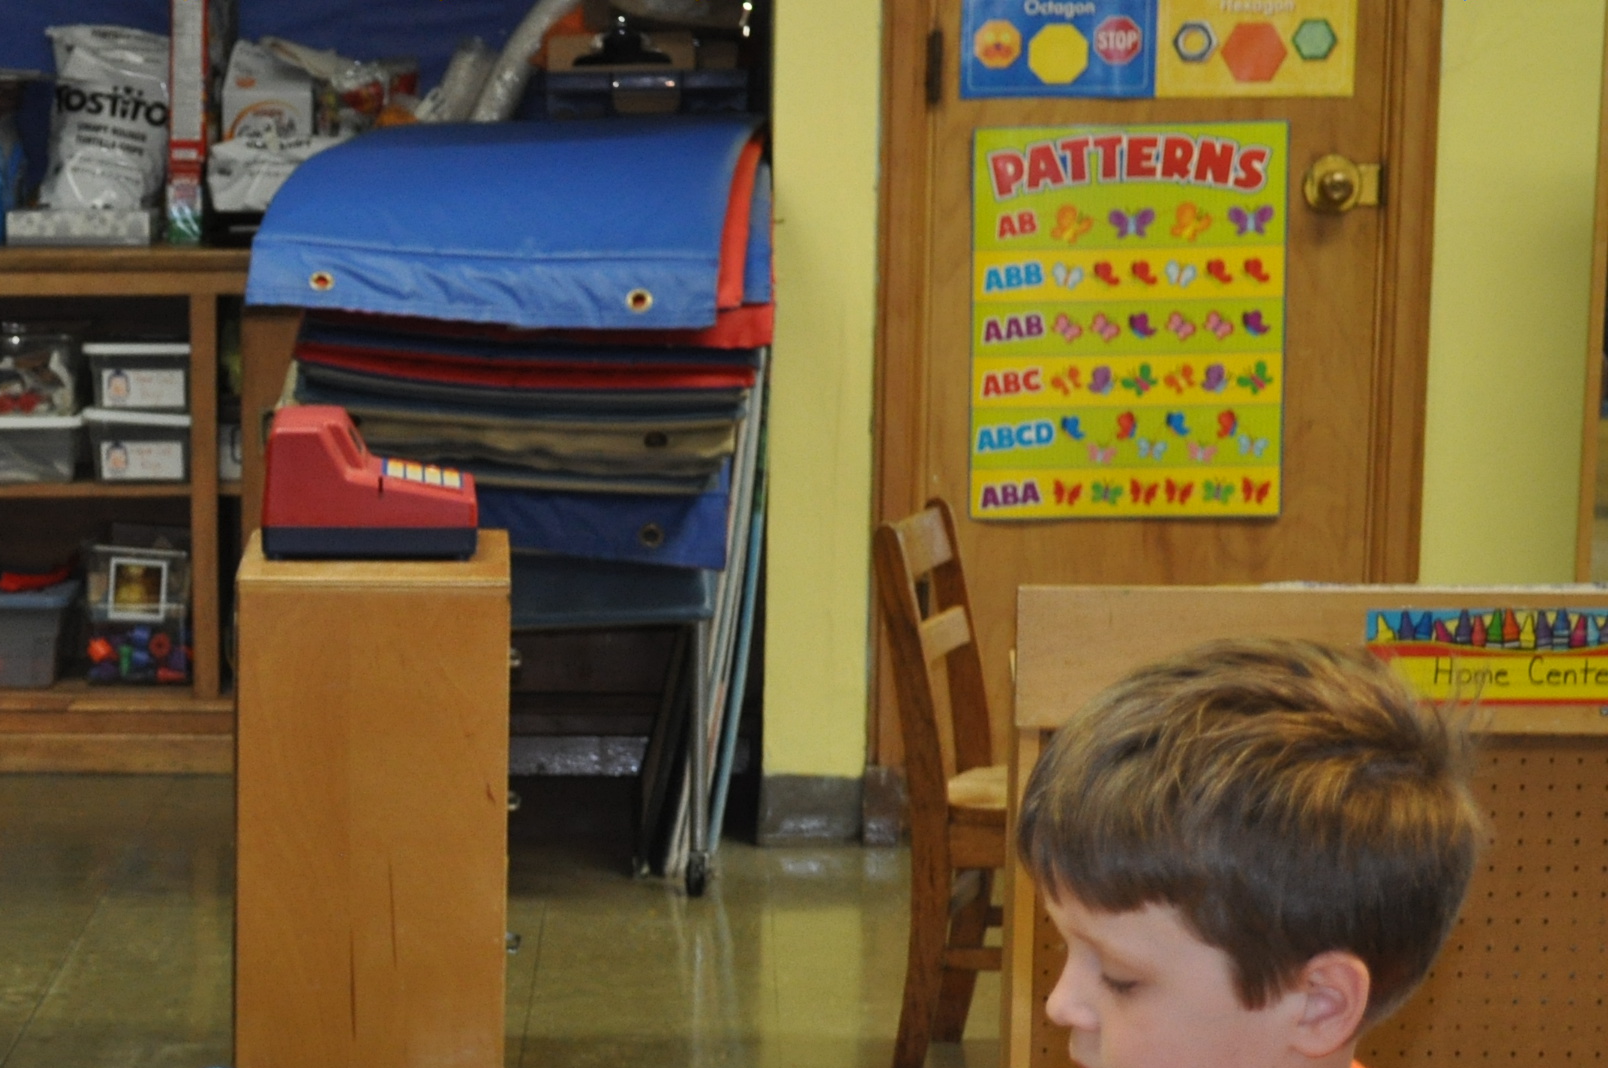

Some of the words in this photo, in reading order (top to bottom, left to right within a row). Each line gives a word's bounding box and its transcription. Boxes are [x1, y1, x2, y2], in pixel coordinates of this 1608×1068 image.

[1023, 0, 1096, 19] Octagon
[1097, 31, 1139, 51] STOP
[55, 85, 169, 126] TOSTITO
[990, 135, 1270, 199] PATTERNS
[997, 211, 1038, 239] AB
[984, 262, 1044, 292] ABB
[983, 315, 1044, 342] AAB
[983, 369, 1042, 396] ABC
[977, 421, 1055, 451] ABCD
[981, 481, 1041, 509] ABA
[1433, 655, 1511, 686] Home
[1528, 654, 1608, 686] Cente
